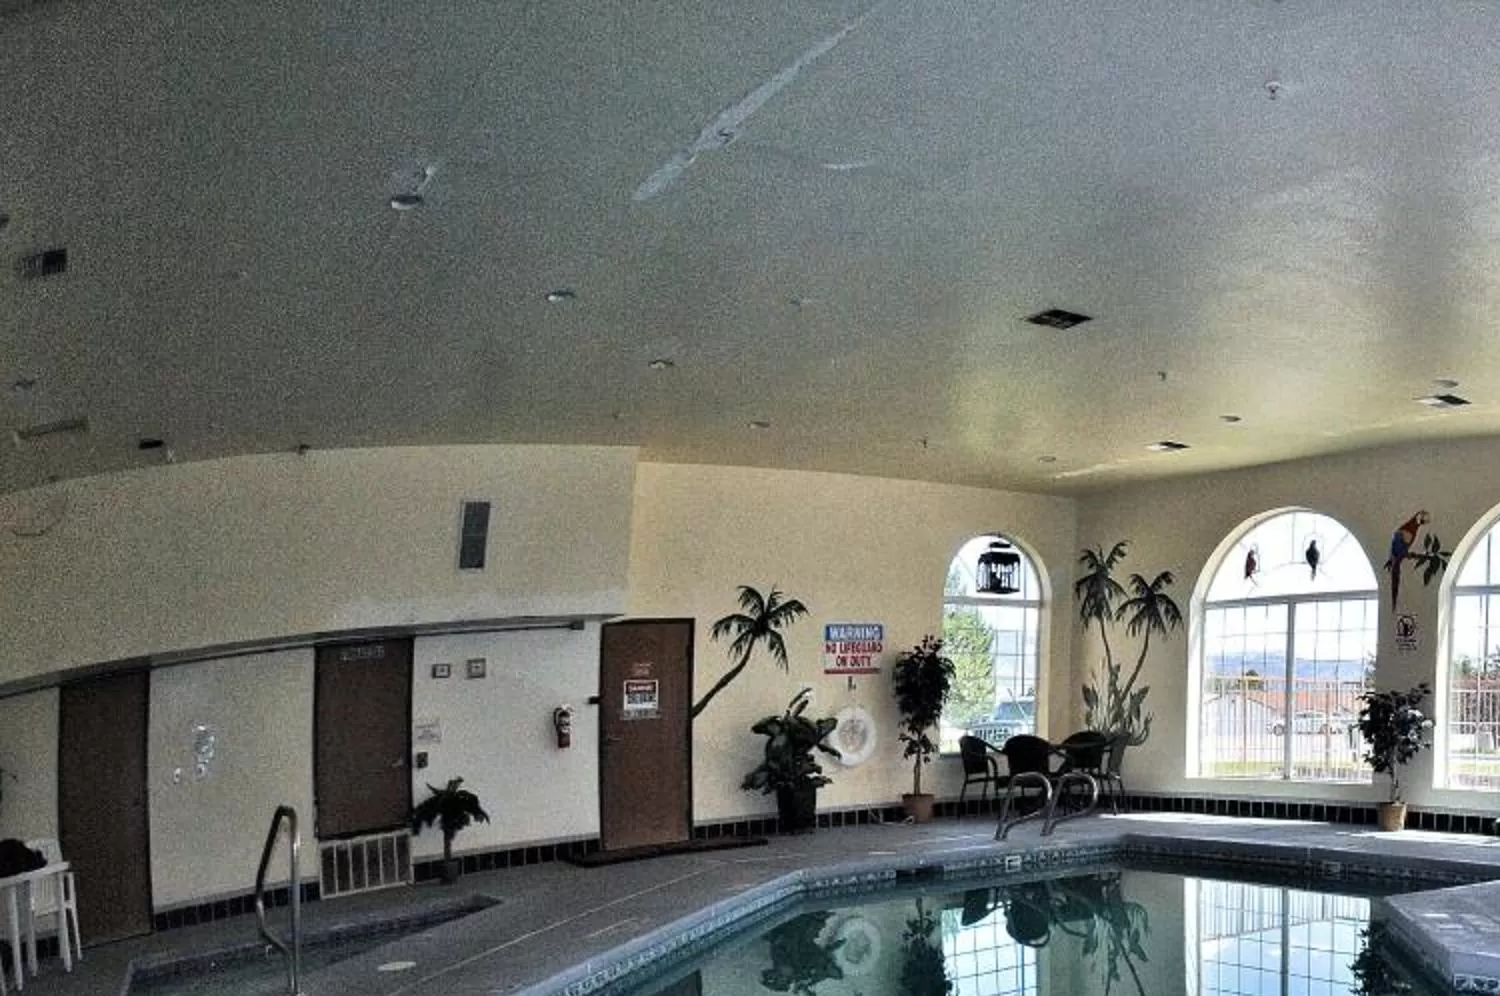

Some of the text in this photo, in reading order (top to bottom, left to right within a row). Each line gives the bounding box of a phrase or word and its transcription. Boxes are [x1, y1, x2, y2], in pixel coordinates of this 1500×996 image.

[829, 626, 881, 640] WARNING
[826, 641, 883, 654] NO LIFEGUARD
[836, 655, 871, 667] ON DUTY
